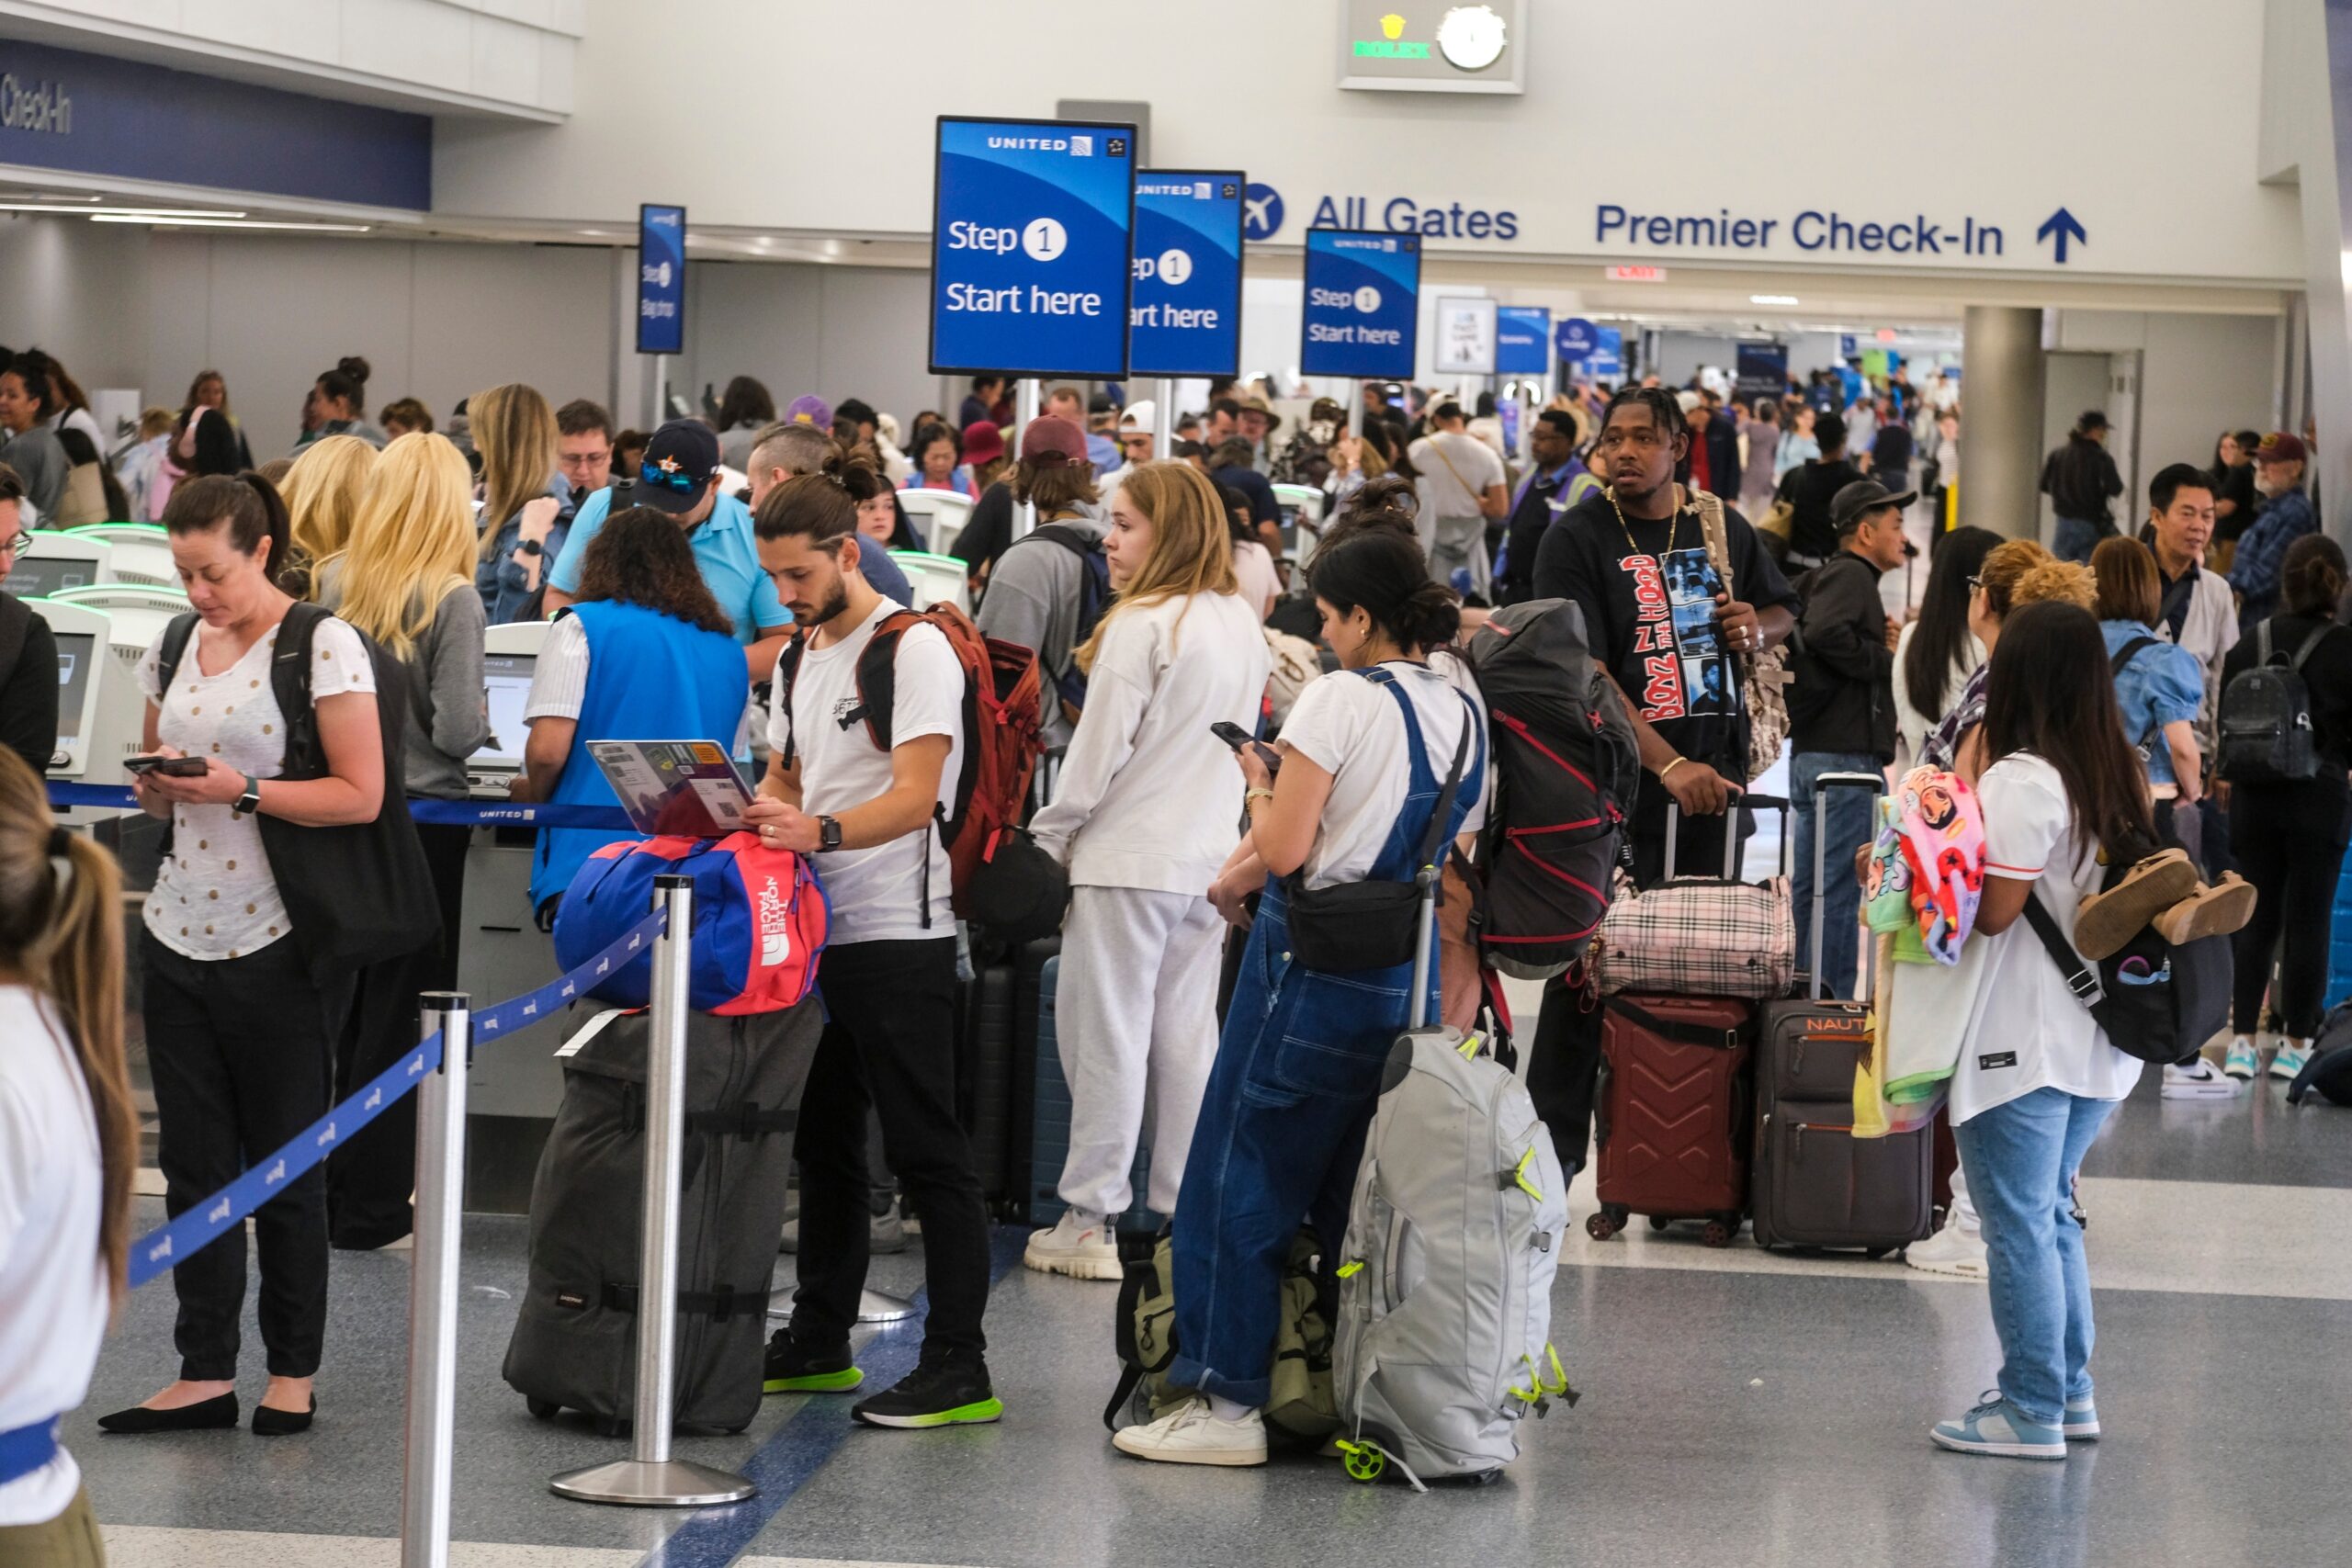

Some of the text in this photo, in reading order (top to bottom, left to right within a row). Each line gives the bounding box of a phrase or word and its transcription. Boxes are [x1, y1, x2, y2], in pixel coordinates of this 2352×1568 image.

[0, 73, 73, 134] Check-In
[988, 137, 1068, 151] UNITED
[1312, 196, 1519, 240] All Gates
[1596, 205, 2003, 255] Premier Check-In
[948, 220, 1018, 255] Step
[1333, 239, 1382, 249] UNITED
[946, 282, 1102, 316] Start here
[1130, 303, 1218, 329] art here
[1310, 288, 1353, 310] Step
[1308, 322, 1402, 345] Start here
[1619, 554, 1685, 723] BOYZ N THE HOOD
[479, 810, 522, 818] UNITED
[757, 891, 772, 934] FACE
[764, 875, 779, 934] NORTH
[778, 898, 788, 933] THE
[1806, 1018, 1866, 1031] NAUT
